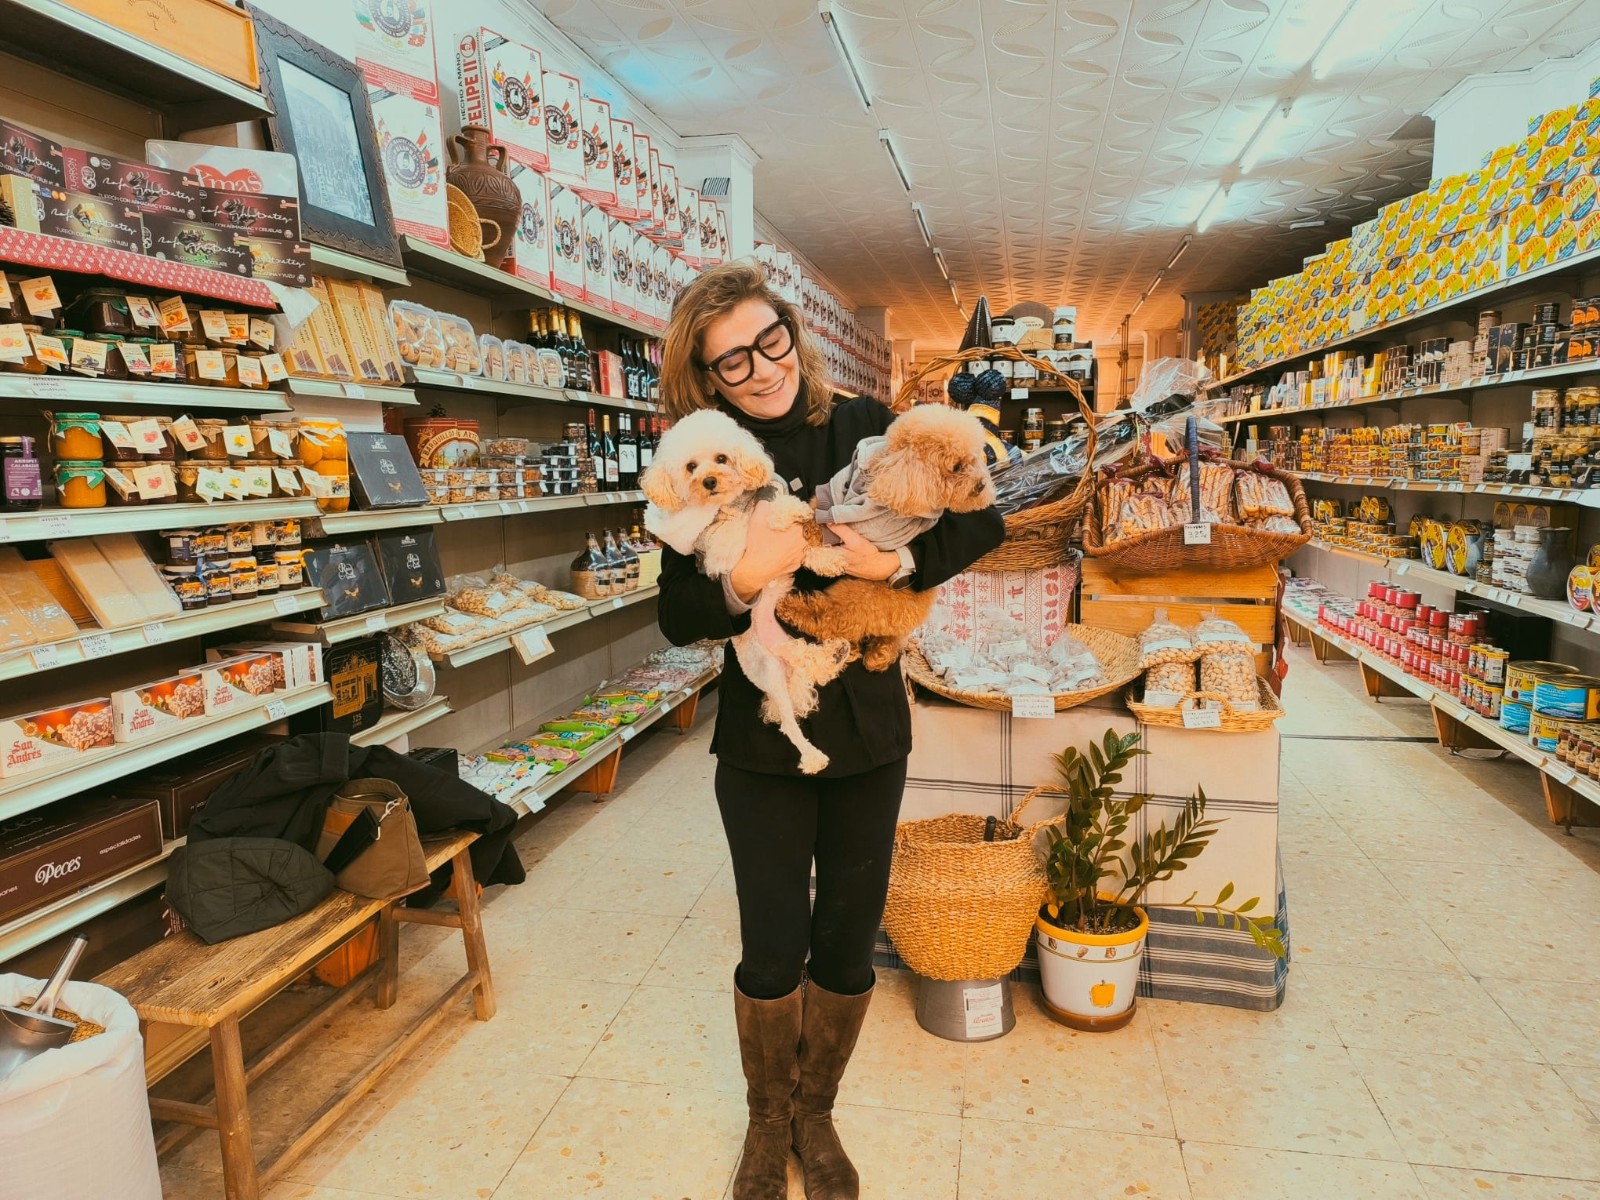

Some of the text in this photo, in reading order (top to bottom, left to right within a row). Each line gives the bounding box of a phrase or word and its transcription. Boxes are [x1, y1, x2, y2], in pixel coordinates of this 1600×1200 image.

[463, 60, 477, 73] II
[458, 89, 466, 120] HECHO
[1565, 176, 1588, 203] ORTIZ
[422, 430, 455, 456] BARQUILLOS
[129, 715, 155, 734] Andrés
[133, 708, 150, 721] San
[11, 740, 33, 754] San
[7, 748, 42, 769] Andrés
[99, 833, 142, 855] especialidades
[35, 856, 82, 886] Peces
